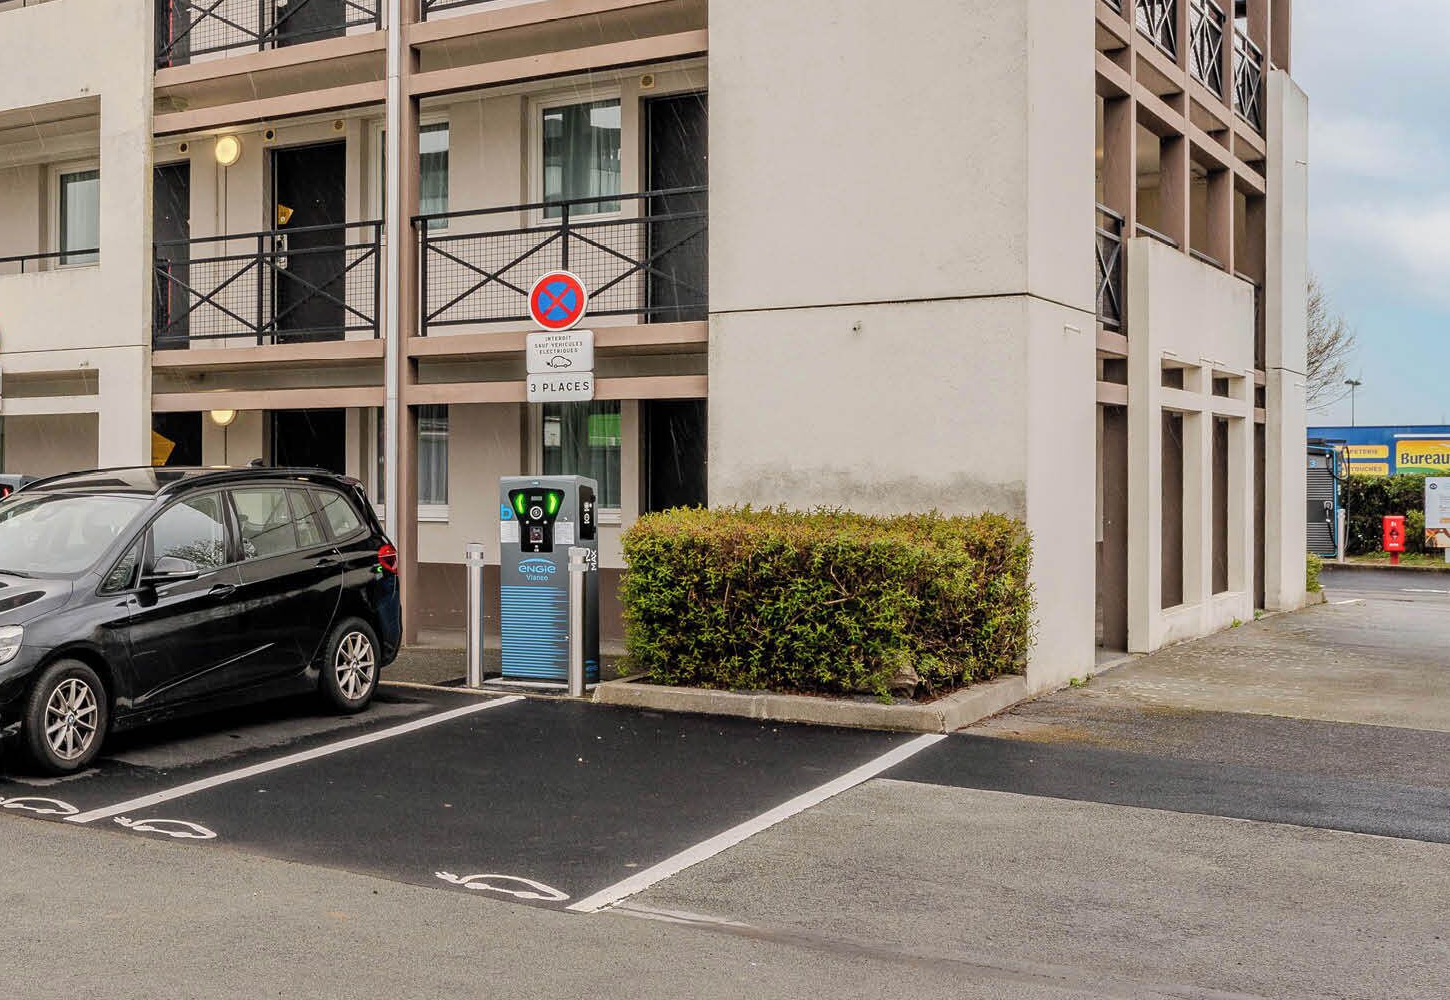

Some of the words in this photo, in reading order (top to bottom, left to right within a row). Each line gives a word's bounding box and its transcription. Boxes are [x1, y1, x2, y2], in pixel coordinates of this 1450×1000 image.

[530, 383, 537, 393] 3
[542, 381, 590, 392] PLACES
[1401, 453, 1450, 465] Bureau
